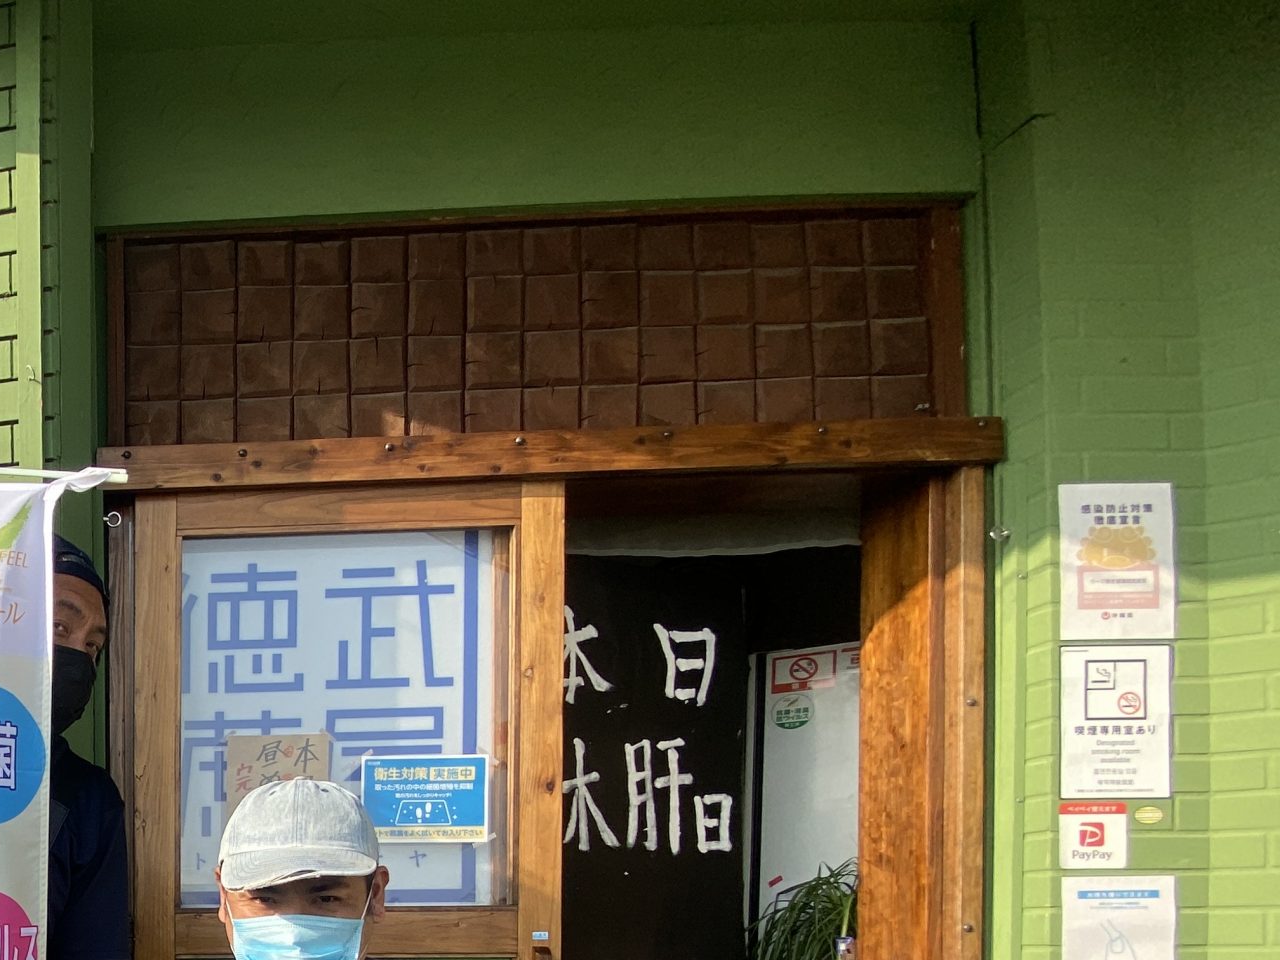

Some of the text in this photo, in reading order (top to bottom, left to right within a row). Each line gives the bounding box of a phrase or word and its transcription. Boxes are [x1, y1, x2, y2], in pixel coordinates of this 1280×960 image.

[1081, 504, 1153, 514] 感染防止対策
[1074, 725, 1156, 735] 喫煙専用室あり
[374, 767, 473, 780] 衛生対策 実施中
[1072, 849, 1112, 861] PayPay
